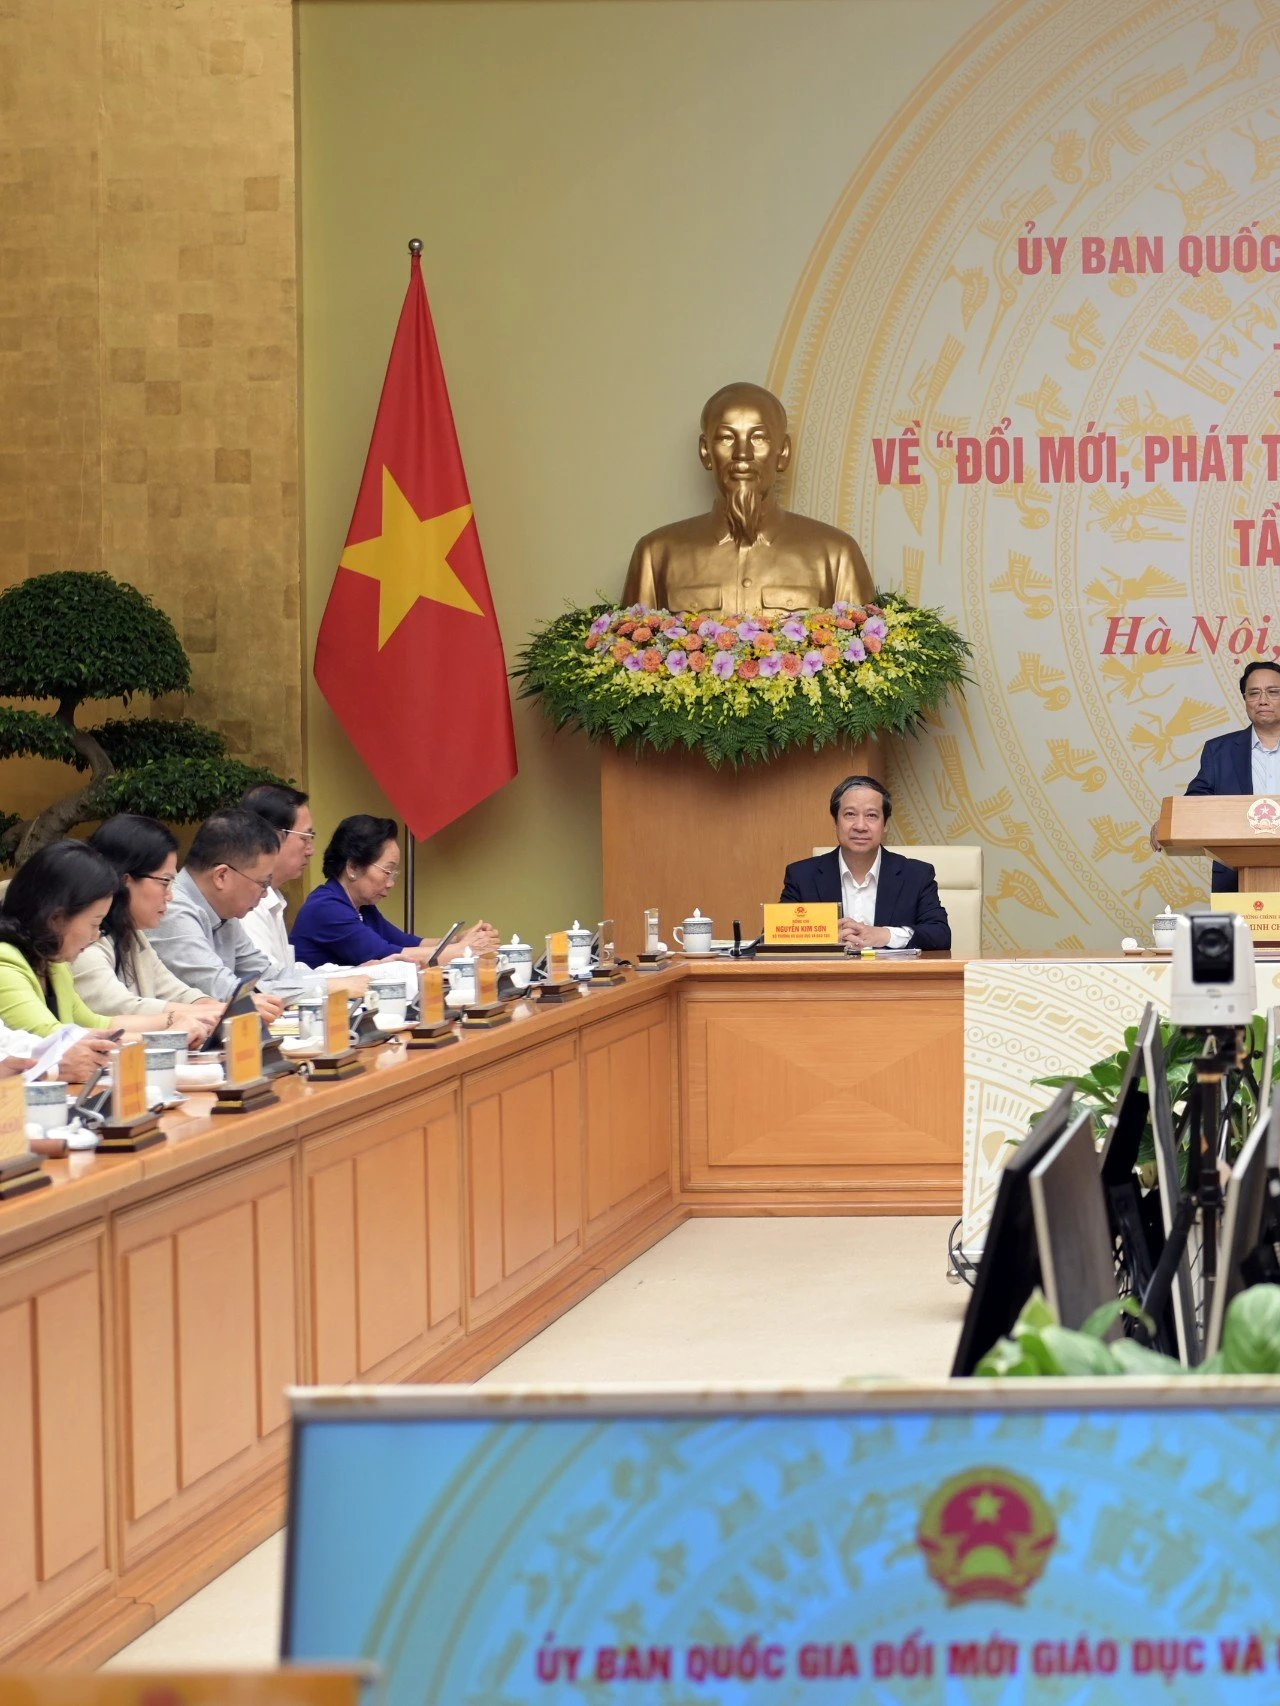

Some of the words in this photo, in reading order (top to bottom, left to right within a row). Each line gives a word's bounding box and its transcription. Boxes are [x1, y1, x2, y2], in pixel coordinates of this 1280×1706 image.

[1018, 221, 1067, 275] ỦY
[1083, 237, 1163, 274] BAN
[872, 420, 921, 485] VỀ
[1040, 421, 1130, 489] MỚI,
[1145, 424, 1249, 483] PHÁT
[1101, 616, 1172, 655] Hà
[775, 924, 800, 933] NGUYỄN
[800, 925, 813, 933] KIM
[813, 925, 827, 933] SƠN
[597, 1647, 672, 1682] BAN
[687, 1634, 785, 1684] QUỐC
[799, 1644, 859, 1679] GIA
[949, 1629, 1018, 1676] MỚI
[1033, 1632, 1118, 1676] GIÁO
[1132, 1640, 1205, 1685] DỤC
[1220, 1629, 1265, 1673] VÀ
